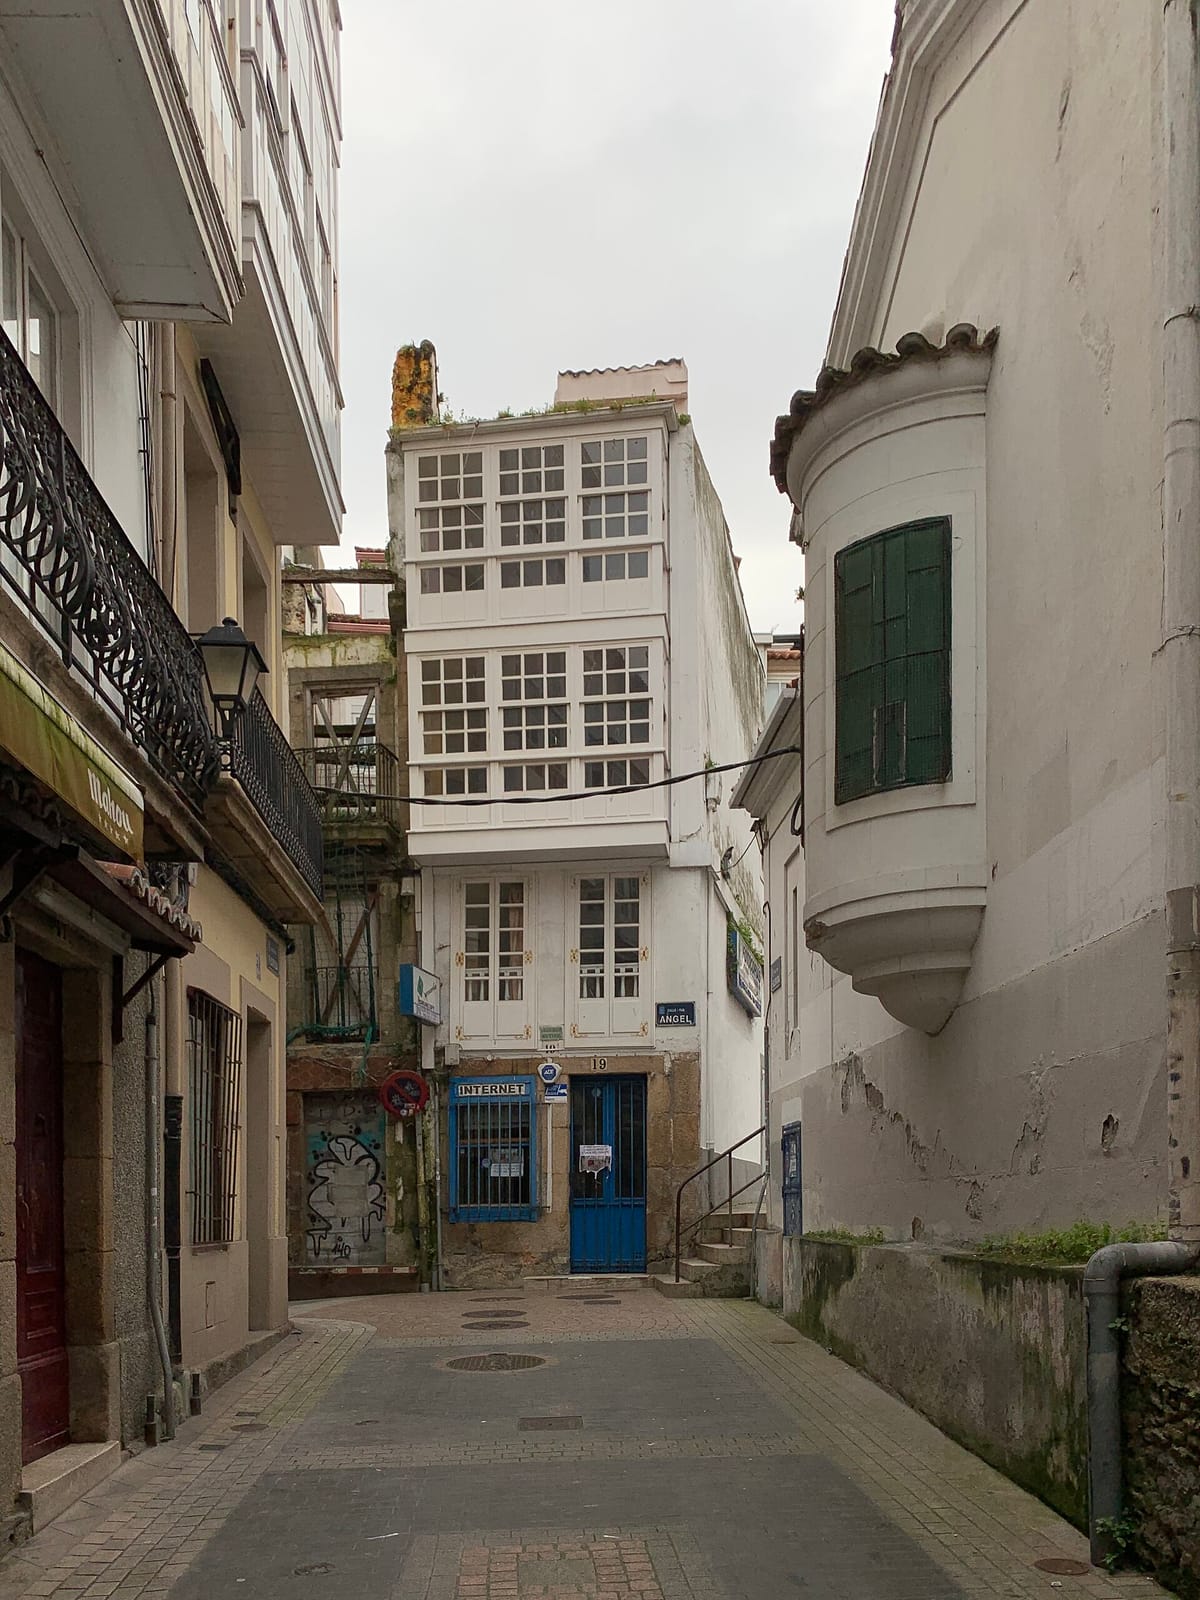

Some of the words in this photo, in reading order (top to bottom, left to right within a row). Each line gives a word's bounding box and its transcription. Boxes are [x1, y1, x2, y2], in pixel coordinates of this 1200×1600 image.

[660, 1015, 691, 1024] ANGEL
[593, 1058, 606, 1070] 19
[459, 1084, 524, 1095] INTERNET
